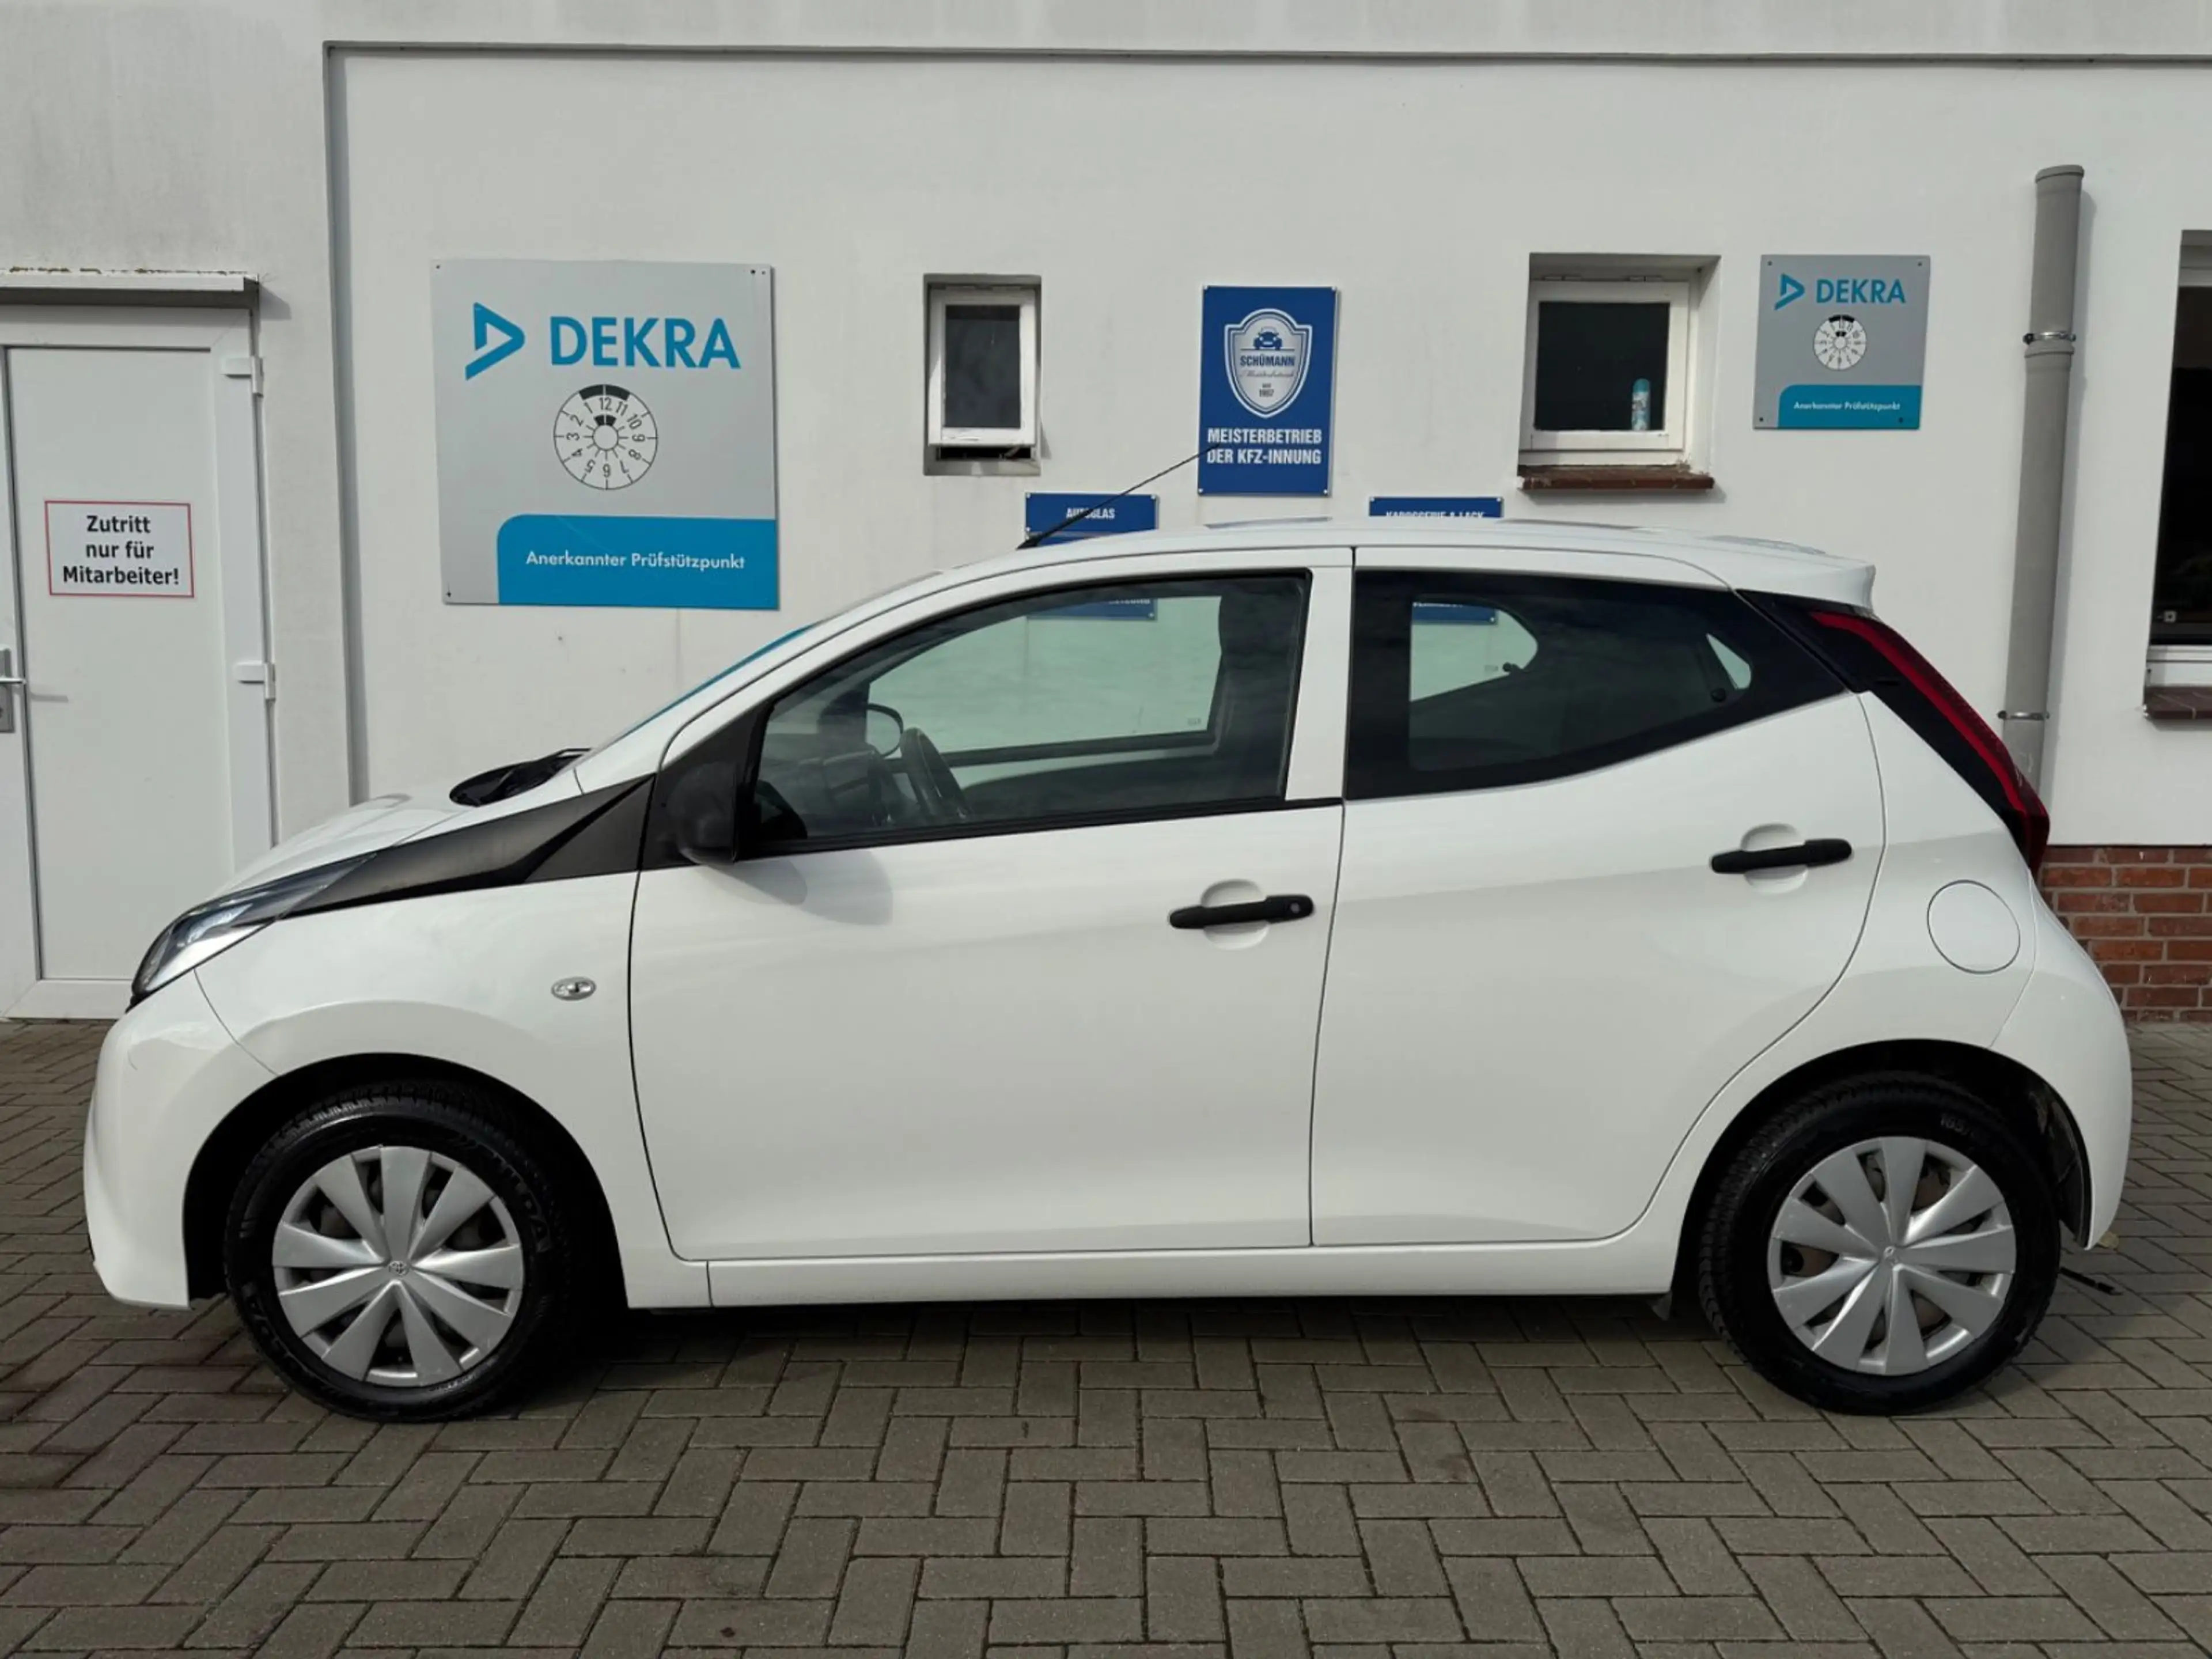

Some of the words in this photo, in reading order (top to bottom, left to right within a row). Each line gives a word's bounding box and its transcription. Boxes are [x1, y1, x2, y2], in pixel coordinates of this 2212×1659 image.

[1816, 279, 1906, 304] DEKRA
[550, 316, 741, 369] DEKRA
[1240, 354, 1295, 367] SCHÜMANN
[599, 397, 612, 410] 12
[616, 402, 628, 416] 11
[570, 415, 584, 427] 2
[627, 414, 642, 430] 10
[566, 433, 580, 441] 3
[1207, 427, 1323, 444] MEISTERBETRIEB
[571, 448, 583, 457] 4
[628, 449, 642, 460] 8
[1207, 448, 1234, 464] DER
[1237, 449, 1322, 464] KFZ-INNUNG
[584, 459, 596, 474] 5
[86, 515, 151, 533] Zutritt
[86, 544, 119, 558] nur
[124, 541, 154, 559] für
[526, 551, 626, 566] Anerkannter
[631, 552, 745, 571] Prüfstützpunkt
[63, 566, 179, 585] Mitarbeiter!
